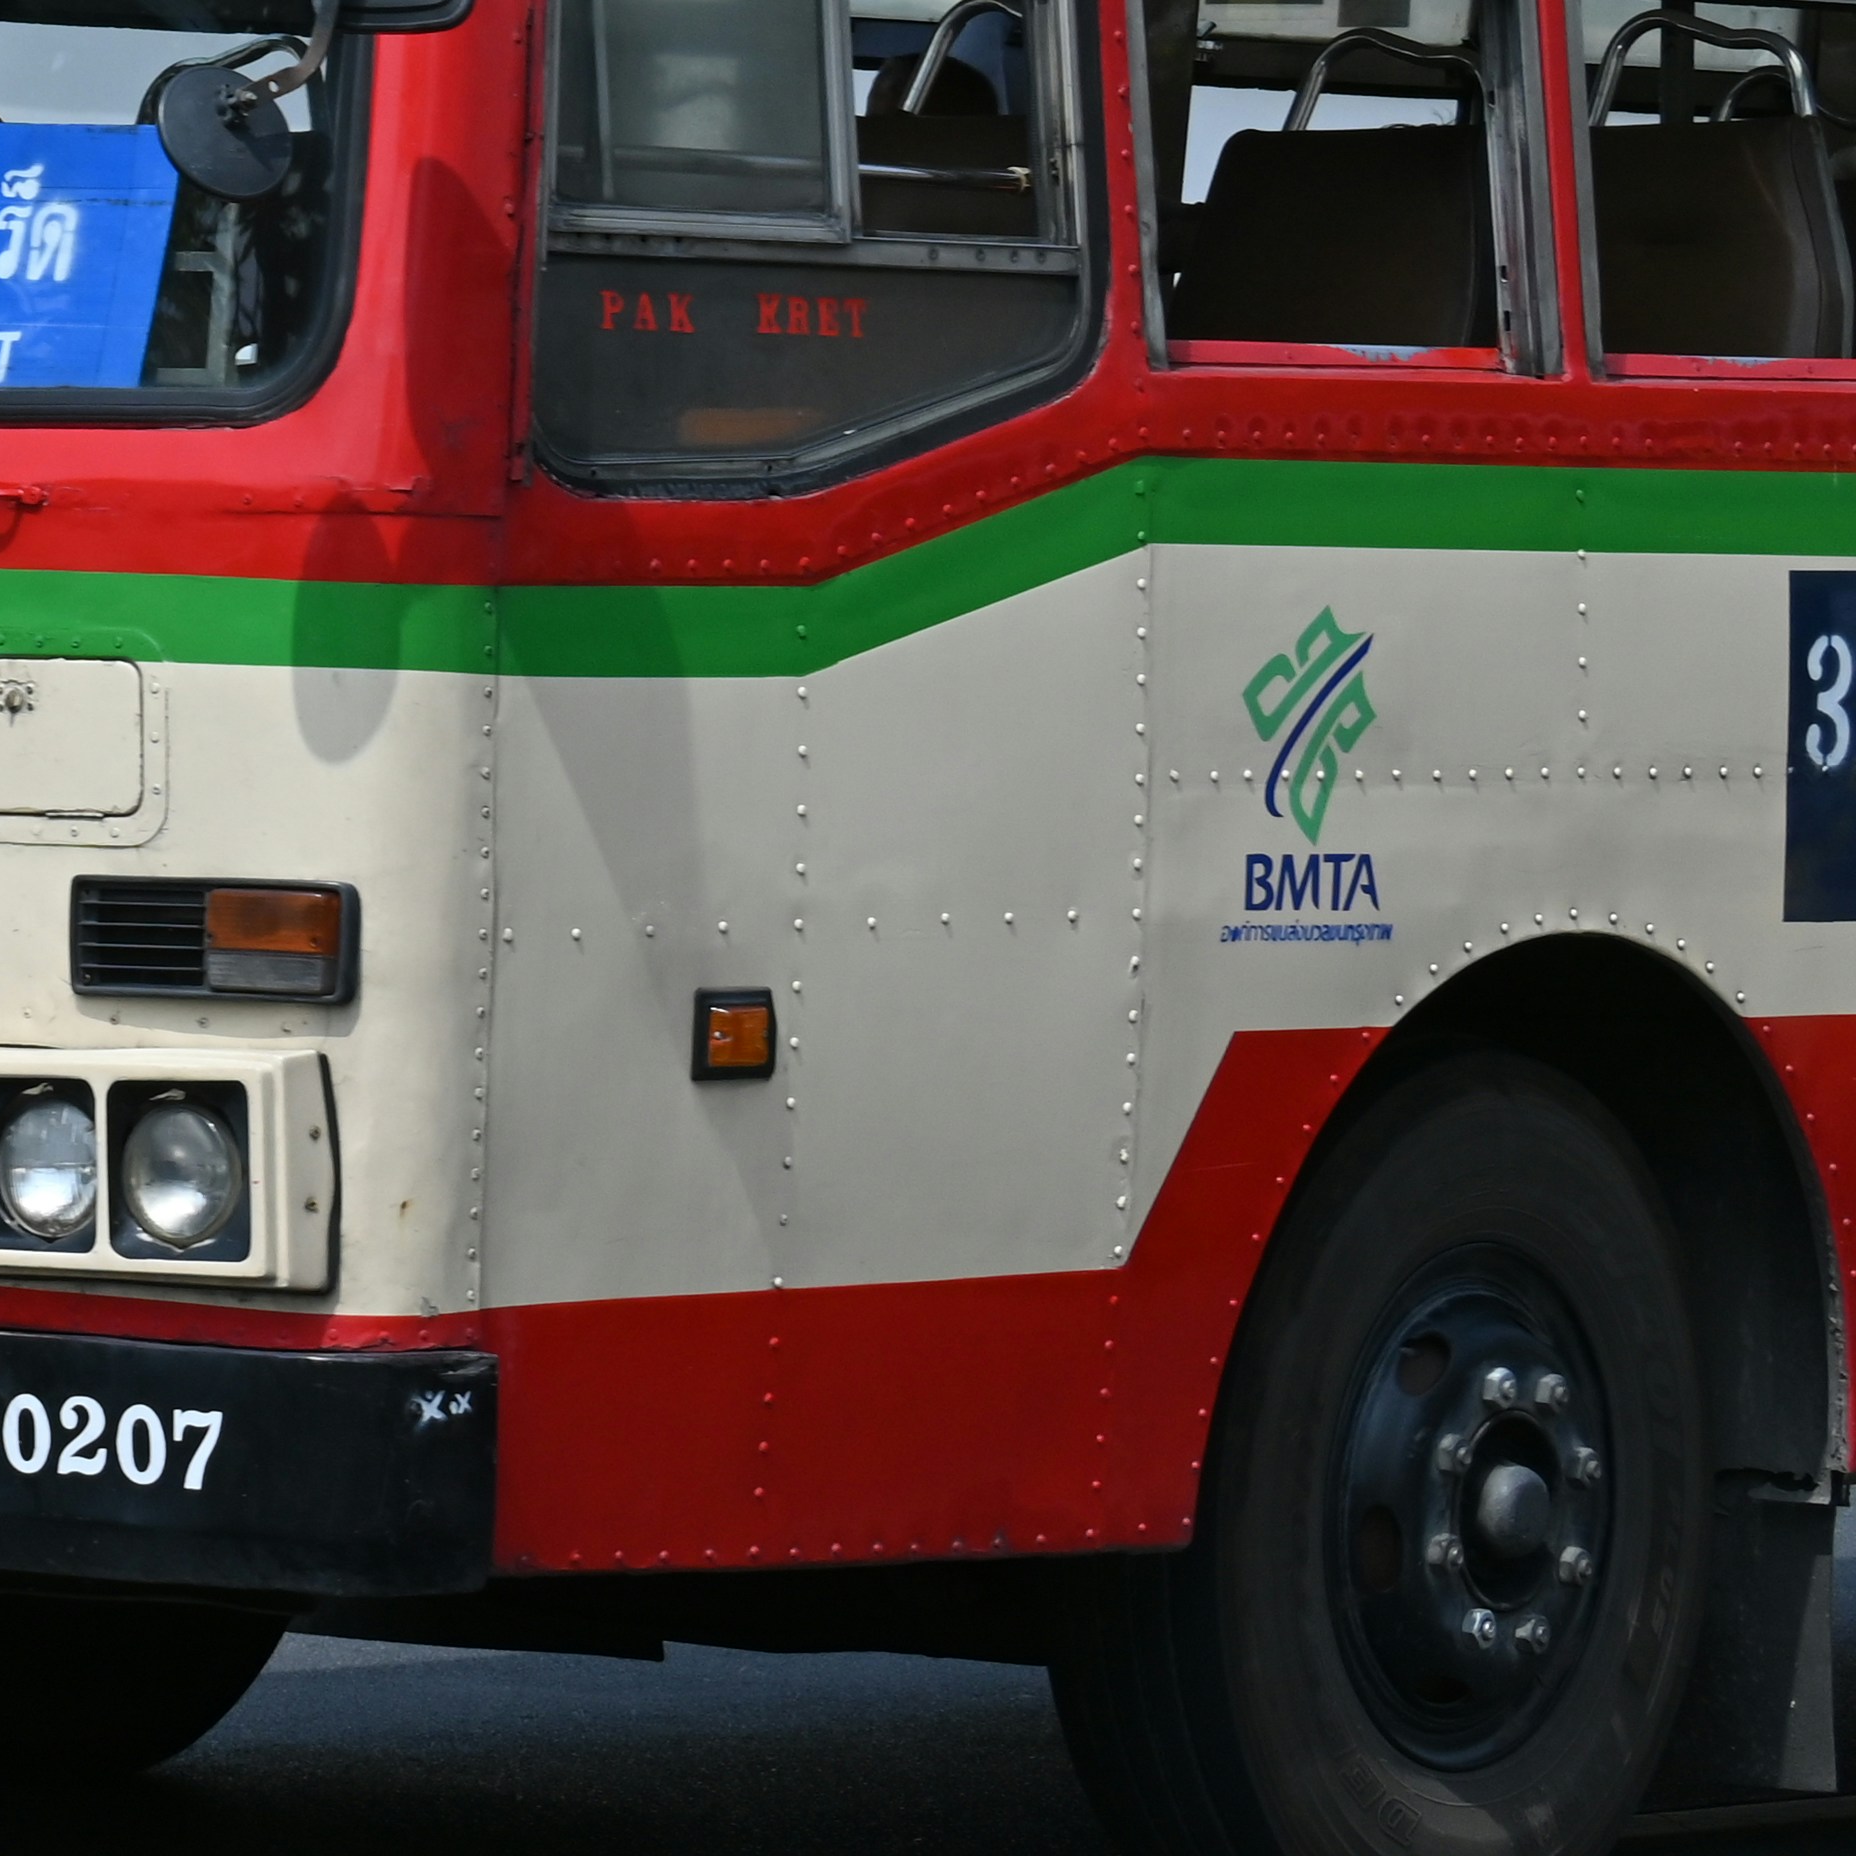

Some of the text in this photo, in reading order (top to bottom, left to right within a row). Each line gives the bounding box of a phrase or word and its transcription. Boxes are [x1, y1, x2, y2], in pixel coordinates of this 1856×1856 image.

[599, 289, 869, 339] PAK KRET
[1243, 853, 1381, 912] BMTA
